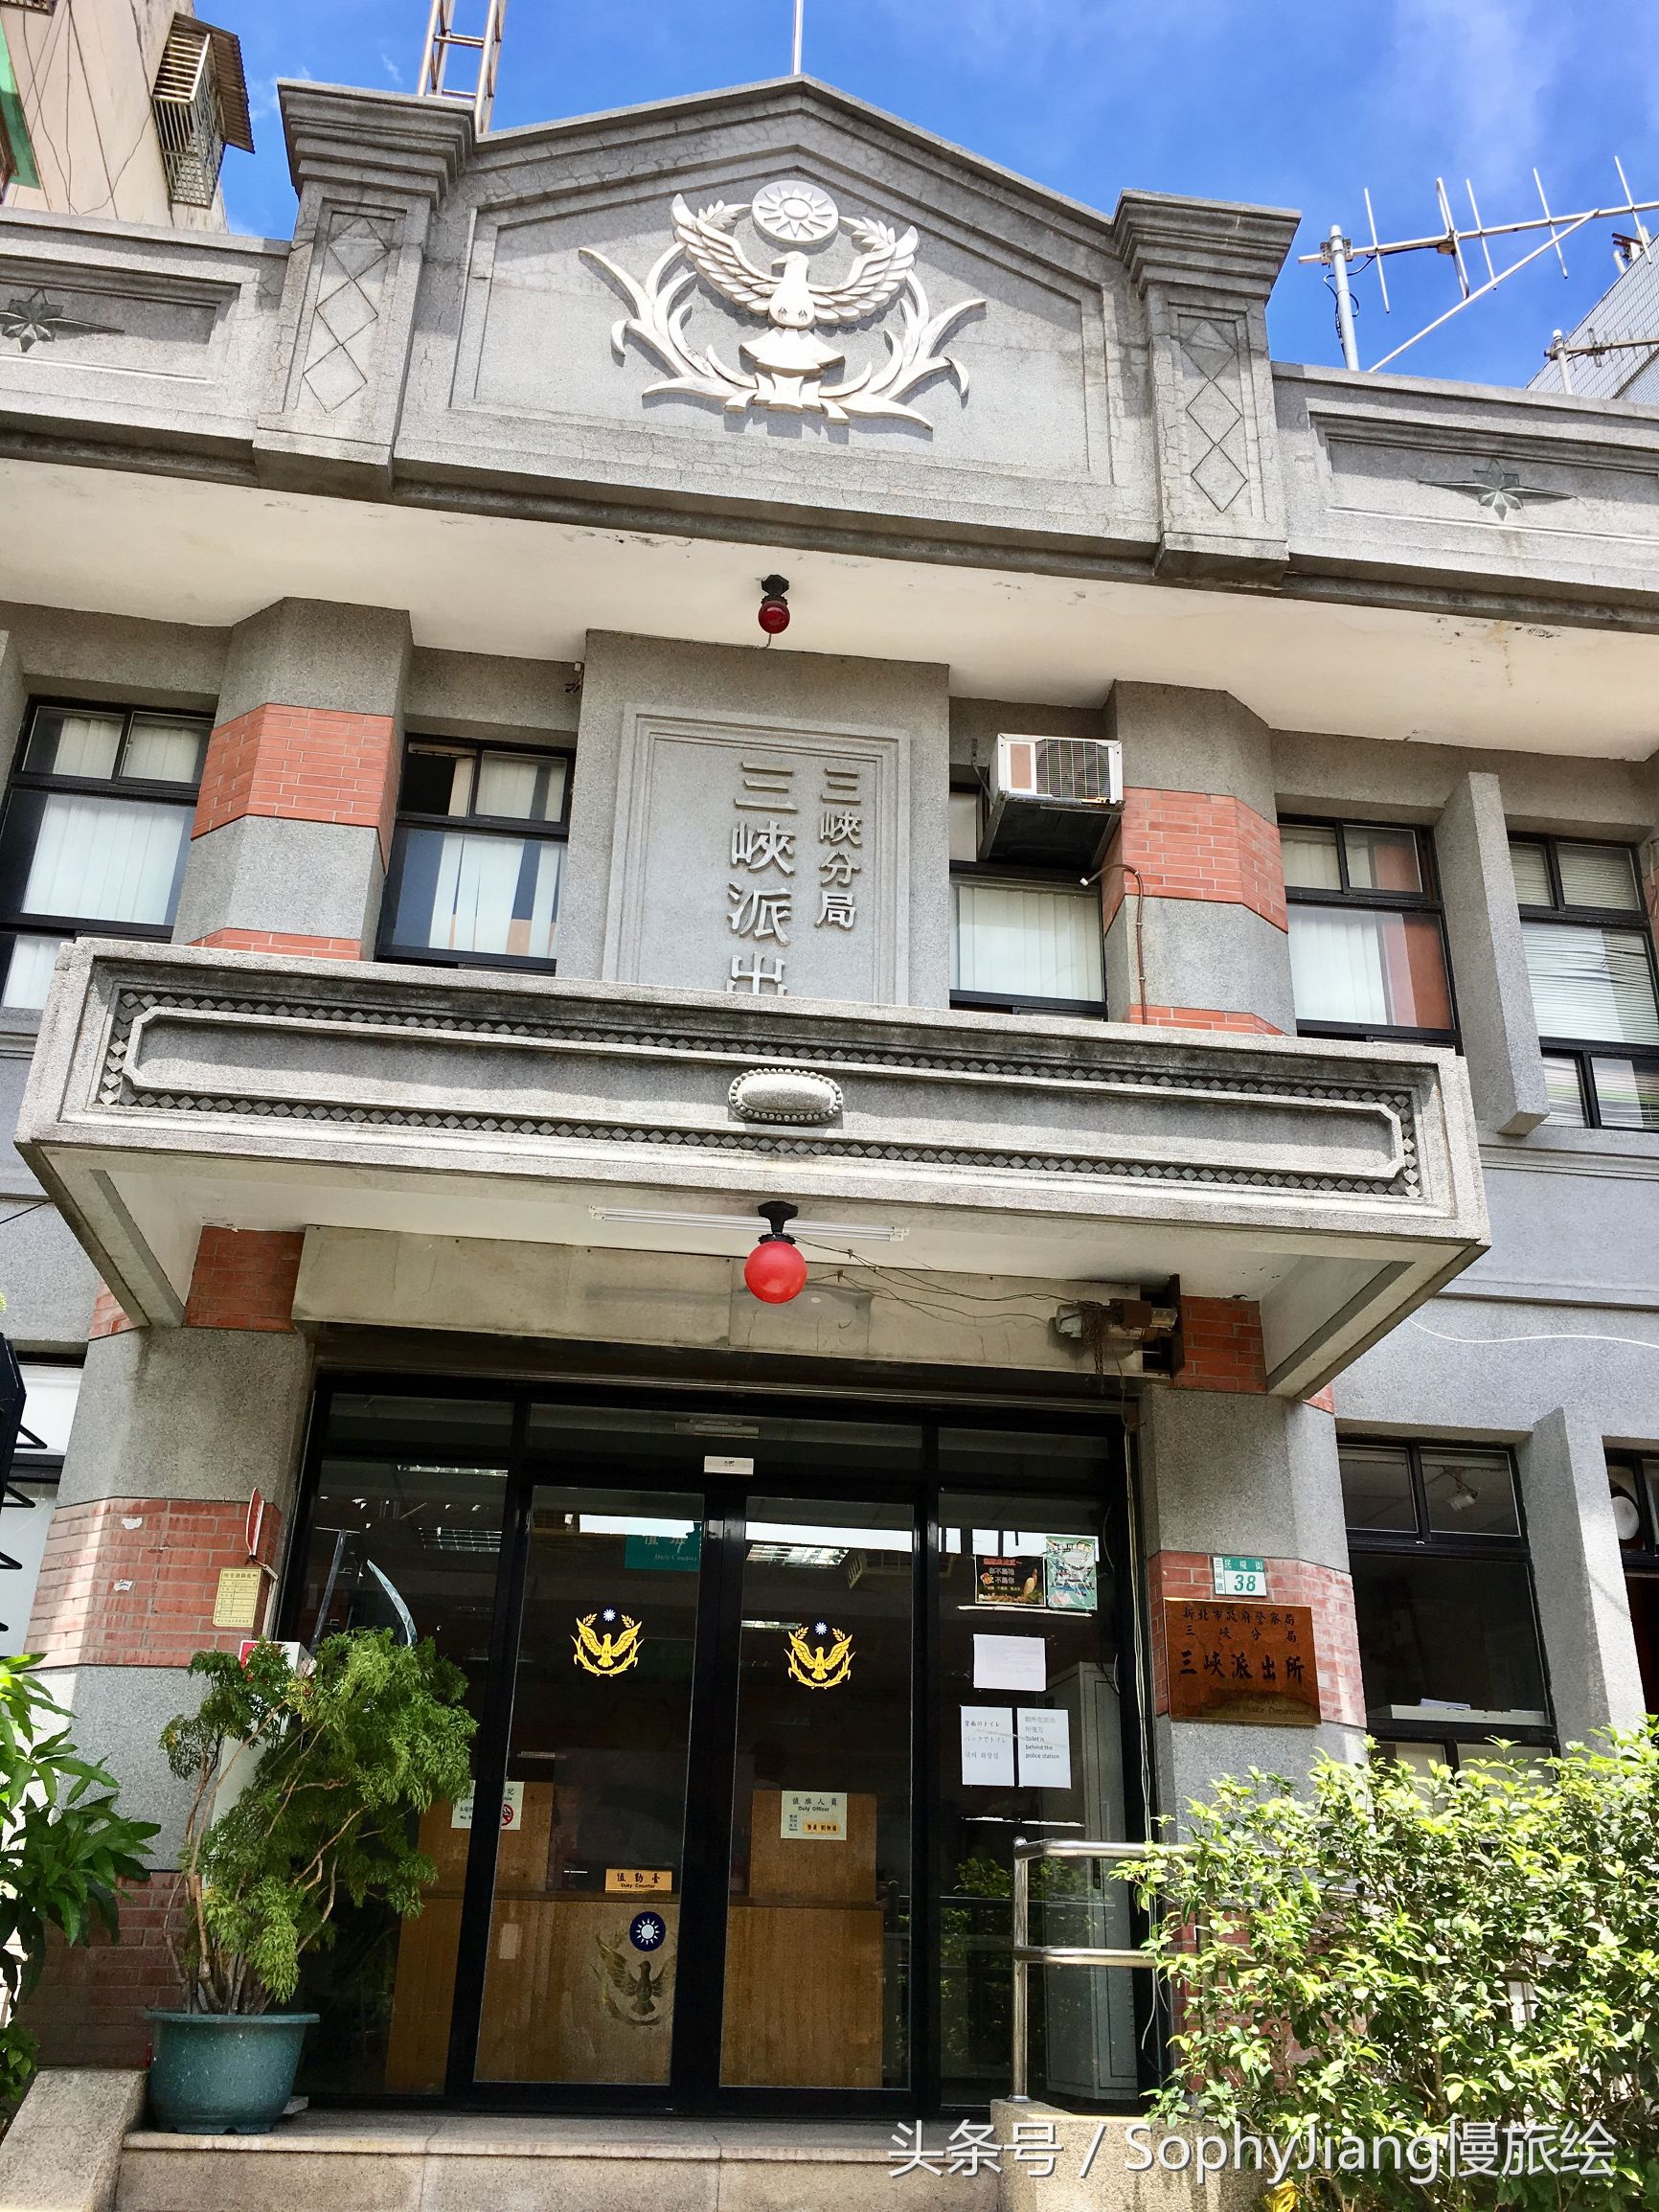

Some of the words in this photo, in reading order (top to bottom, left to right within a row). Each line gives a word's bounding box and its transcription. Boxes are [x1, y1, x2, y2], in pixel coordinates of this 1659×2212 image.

[814, 767, 862, 930] 三峽分局
[1234, 1574, 1257, 1592] 38
[1183, 1608, 1295, 1626] 新北市政府警察局
[1180, 1650, 1305, 1684] 三峽派出所
